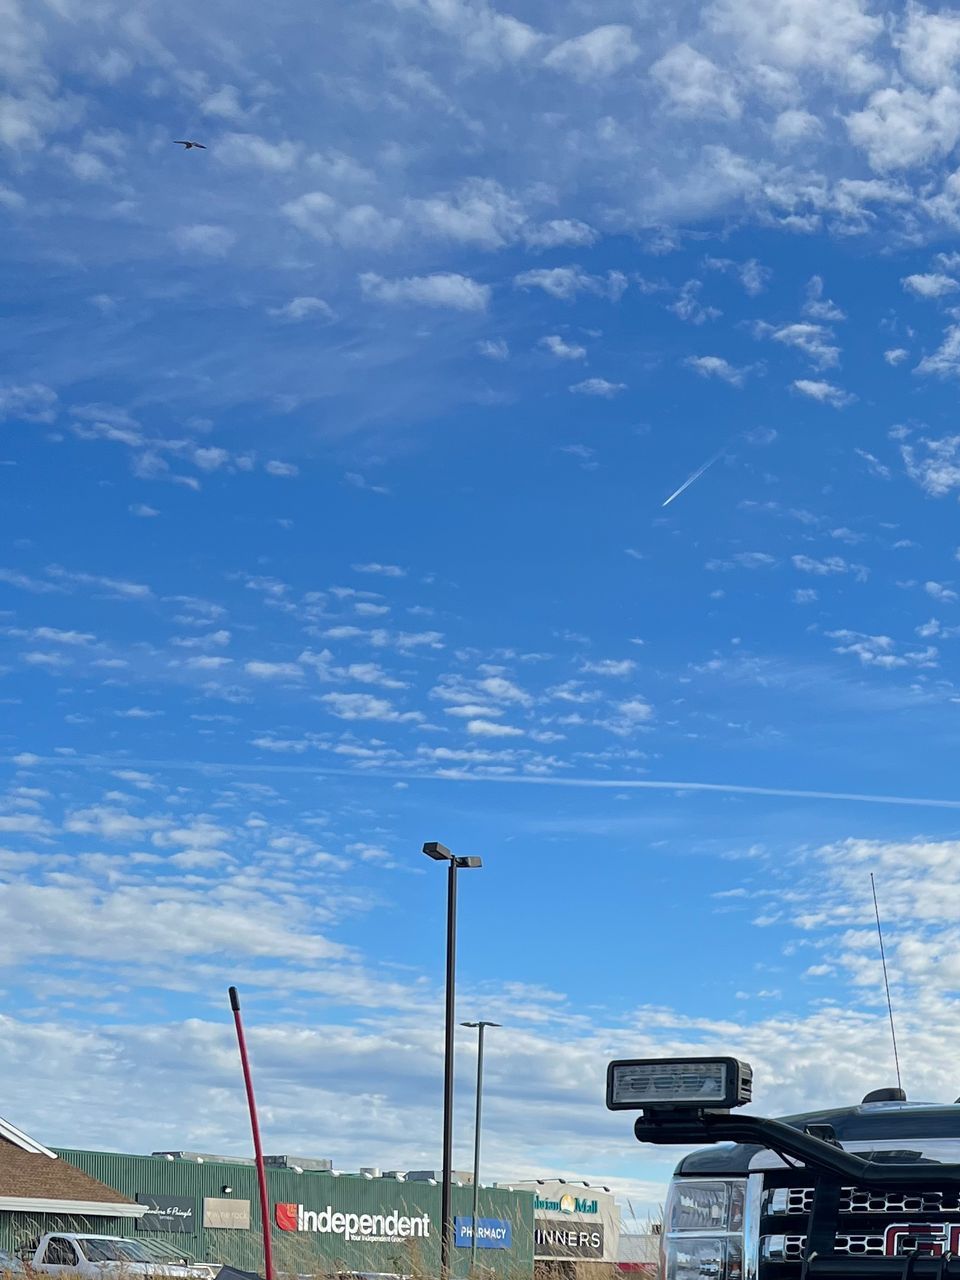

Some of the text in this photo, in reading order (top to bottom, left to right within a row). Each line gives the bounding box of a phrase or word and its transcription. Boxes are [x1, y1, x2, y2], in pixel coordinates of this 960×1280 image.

[534, 1195, 598, 1214] brian Mall
[298, 1203, 430, 1241] Independent
[537, 1229, 601, 1248] INNERS
